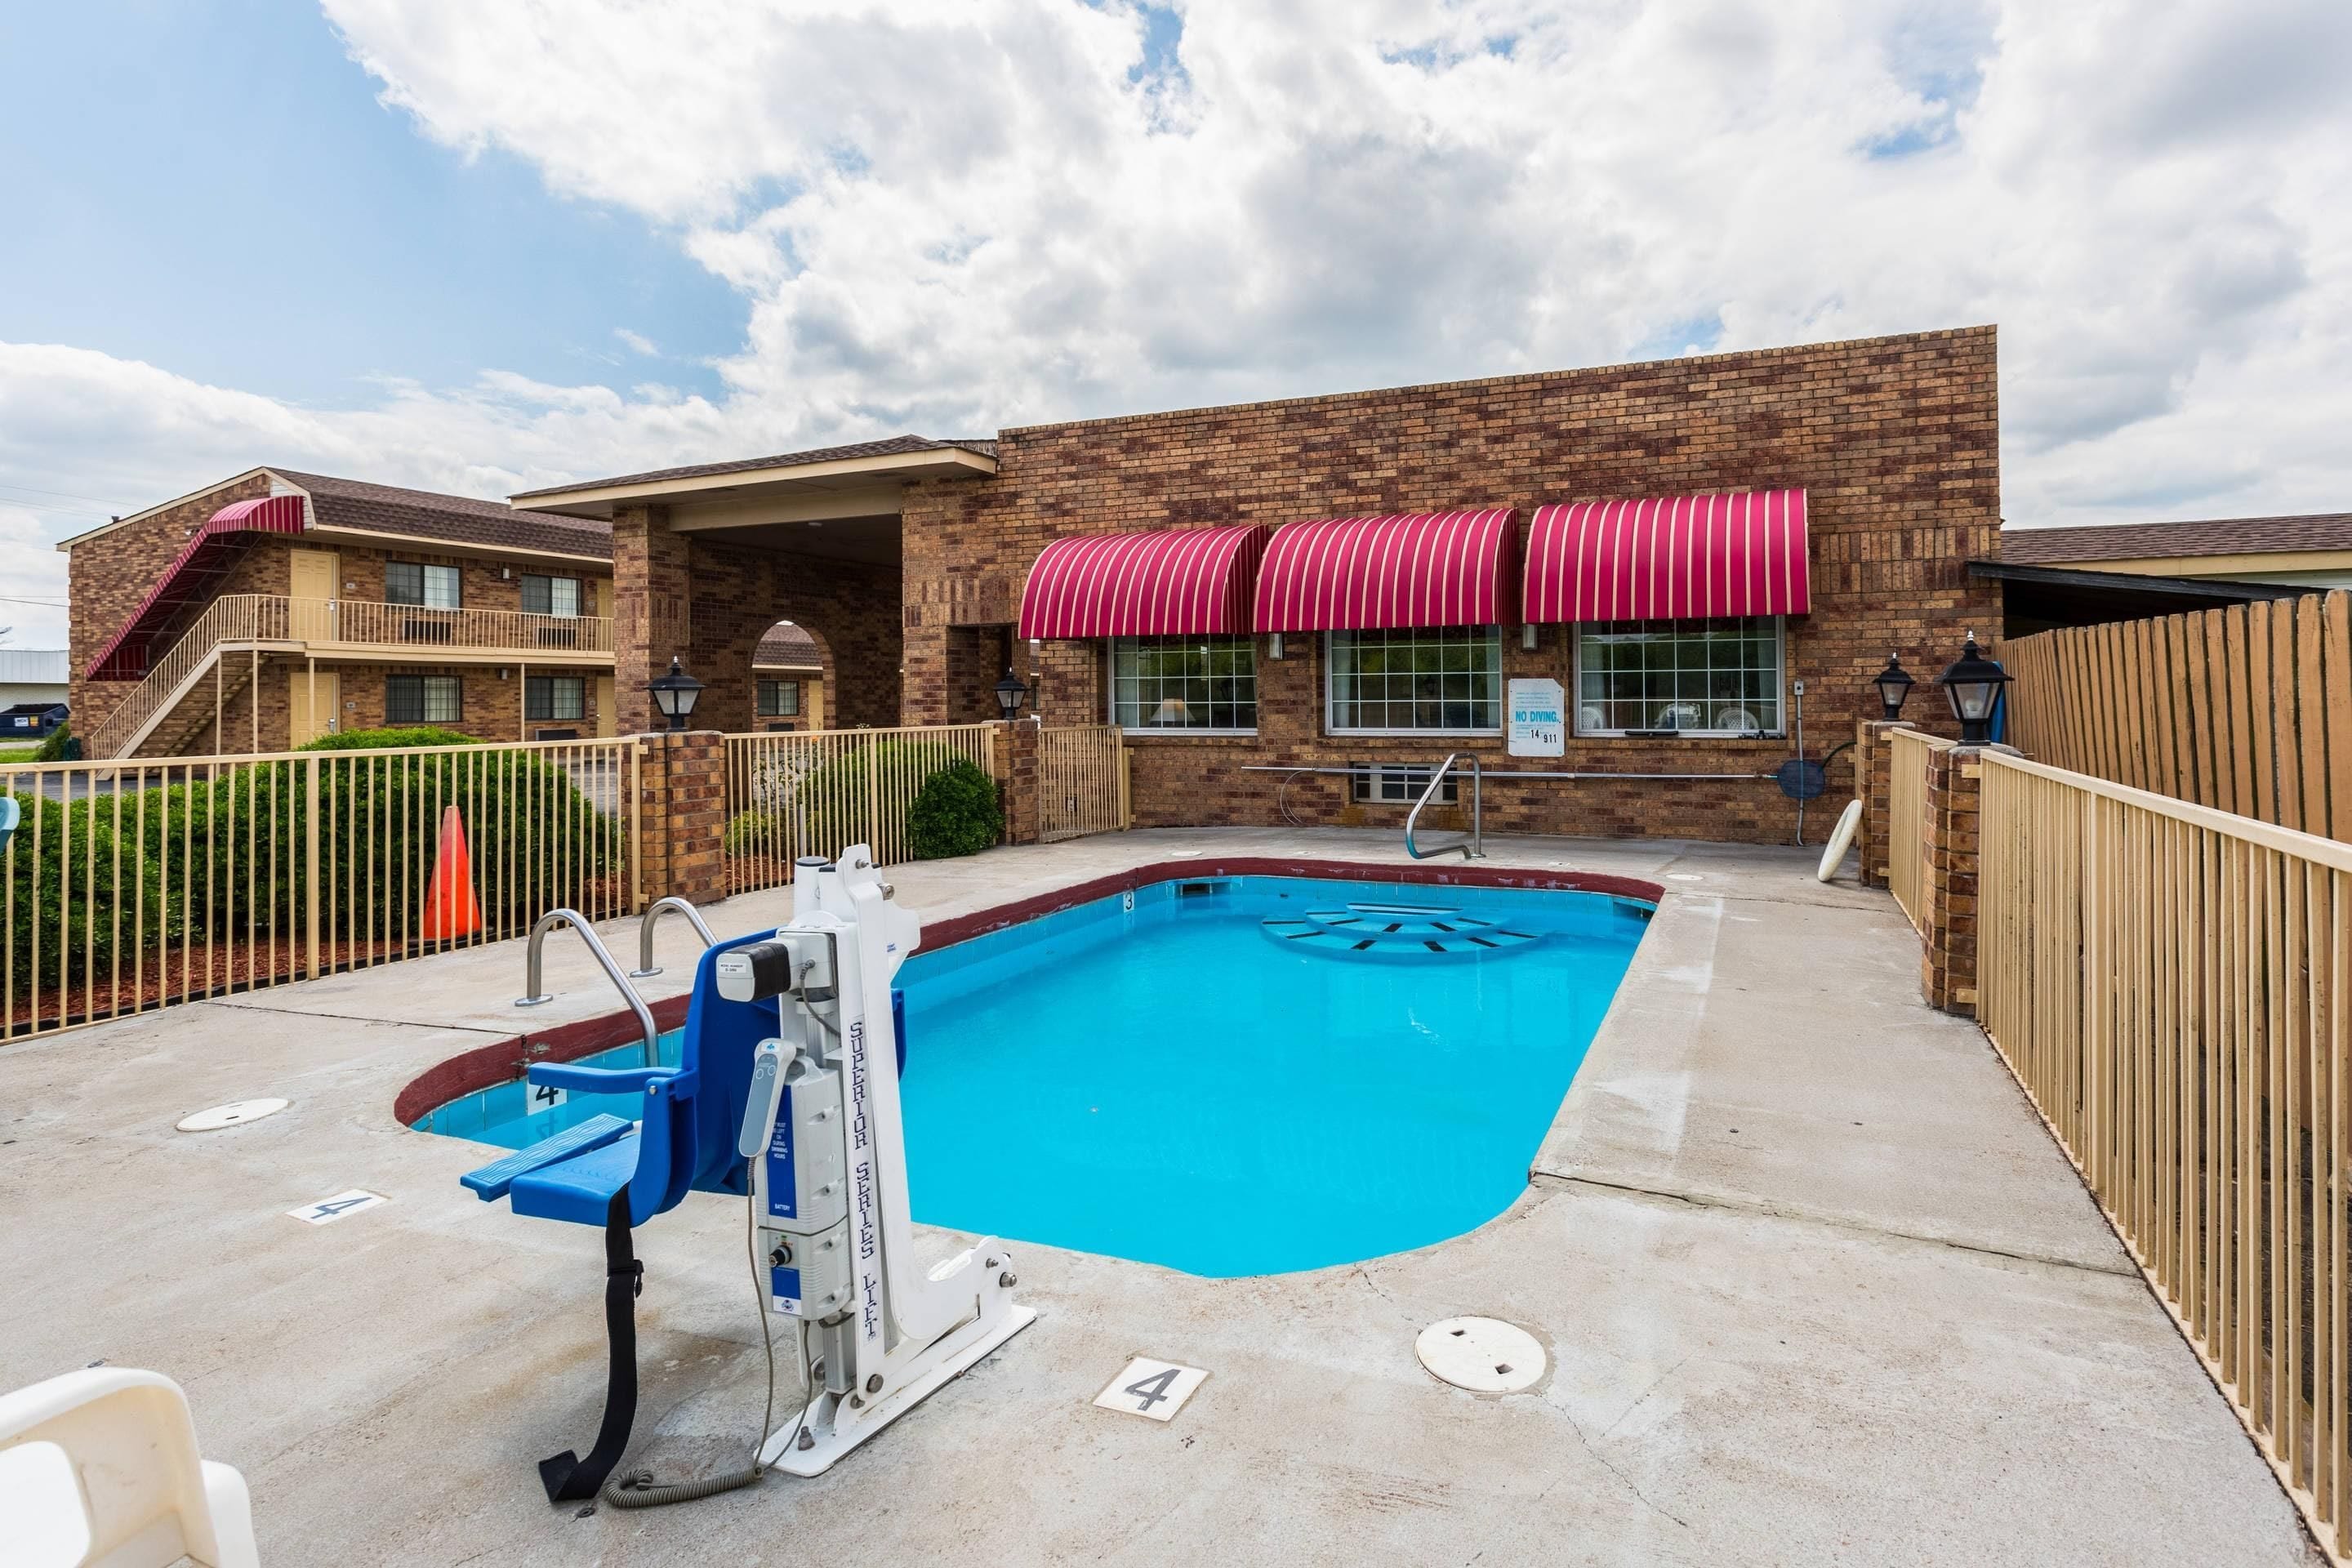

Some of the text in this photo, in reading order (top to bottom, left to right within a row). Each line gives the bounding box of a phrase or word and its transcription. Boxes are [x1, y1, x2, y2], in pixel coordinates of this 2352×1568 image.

[1515, 710, 1527, 723] NO
[1530, 729, 1539, 739] 14
[1544, 733, 1557, 743] 911
[1125, 892, 1133, 911] 3
[536, 1085, 559, 1106] 4
[850, 1022, 868, 1150] SUPERIOR
[310, 1196, 373, 1219] 4
[774, 1203, 791, 1211] BATTERY
[856, 1162, 875, 1259] SERIES
[862, 1272, 878, 1335] LIFT
[1123, 1368, 1183, 1412] 4
